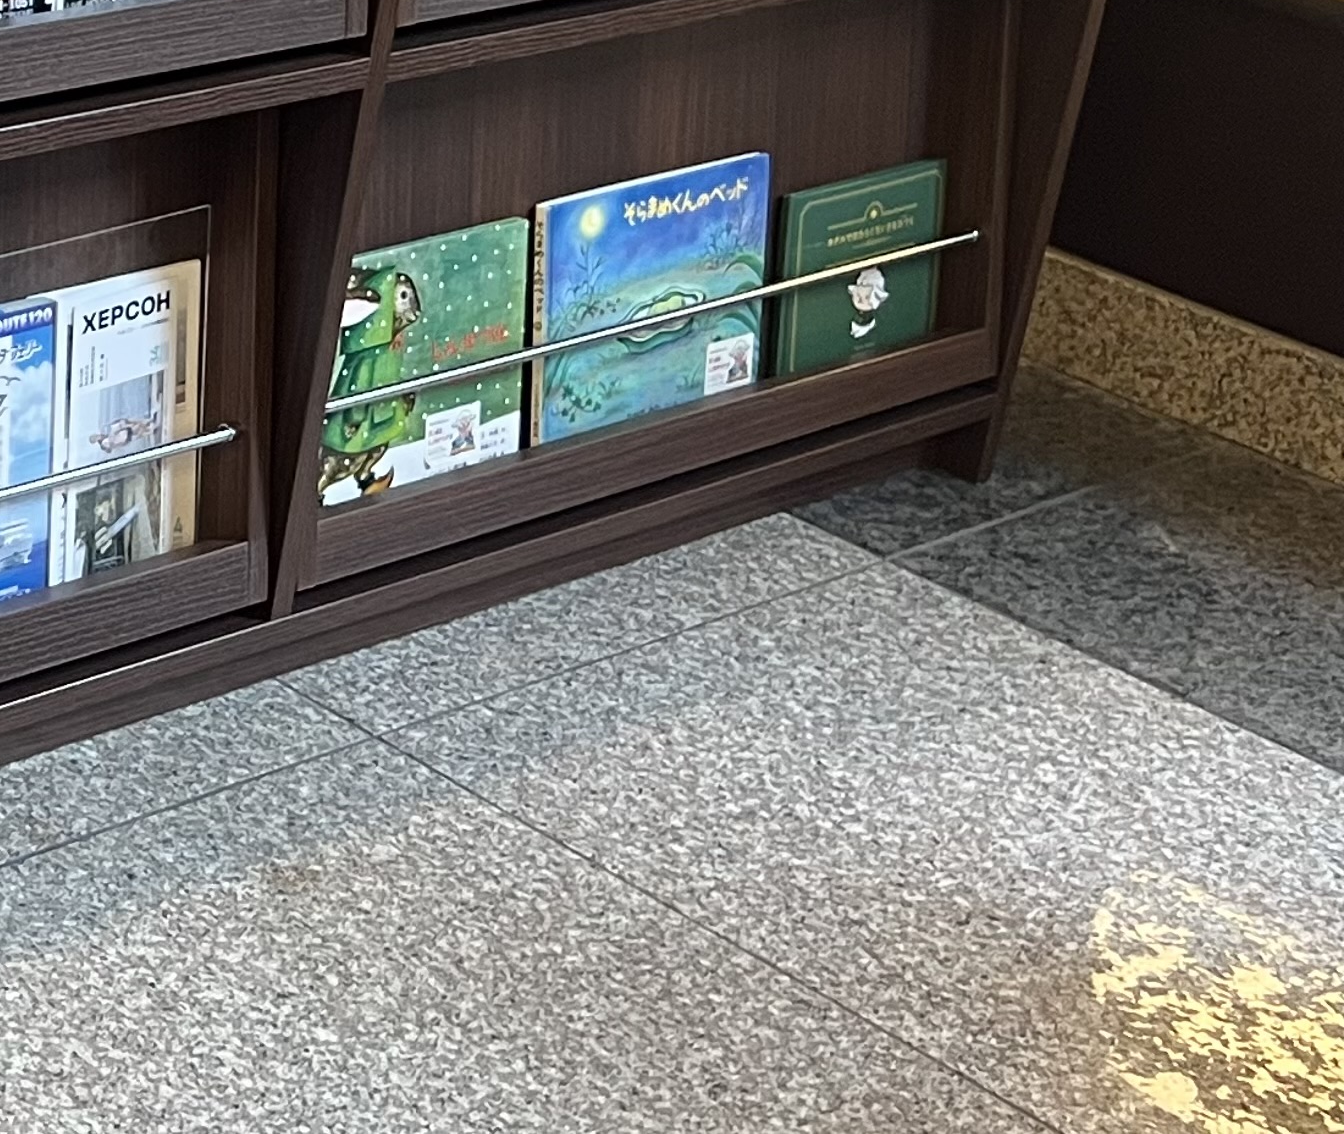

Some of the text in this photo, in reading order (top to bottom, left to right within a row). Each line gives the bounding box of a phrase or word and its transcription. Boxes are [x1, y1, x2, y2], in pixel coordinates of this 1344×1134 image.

[623, 176, 749, 227] そらまめくんのベッド
